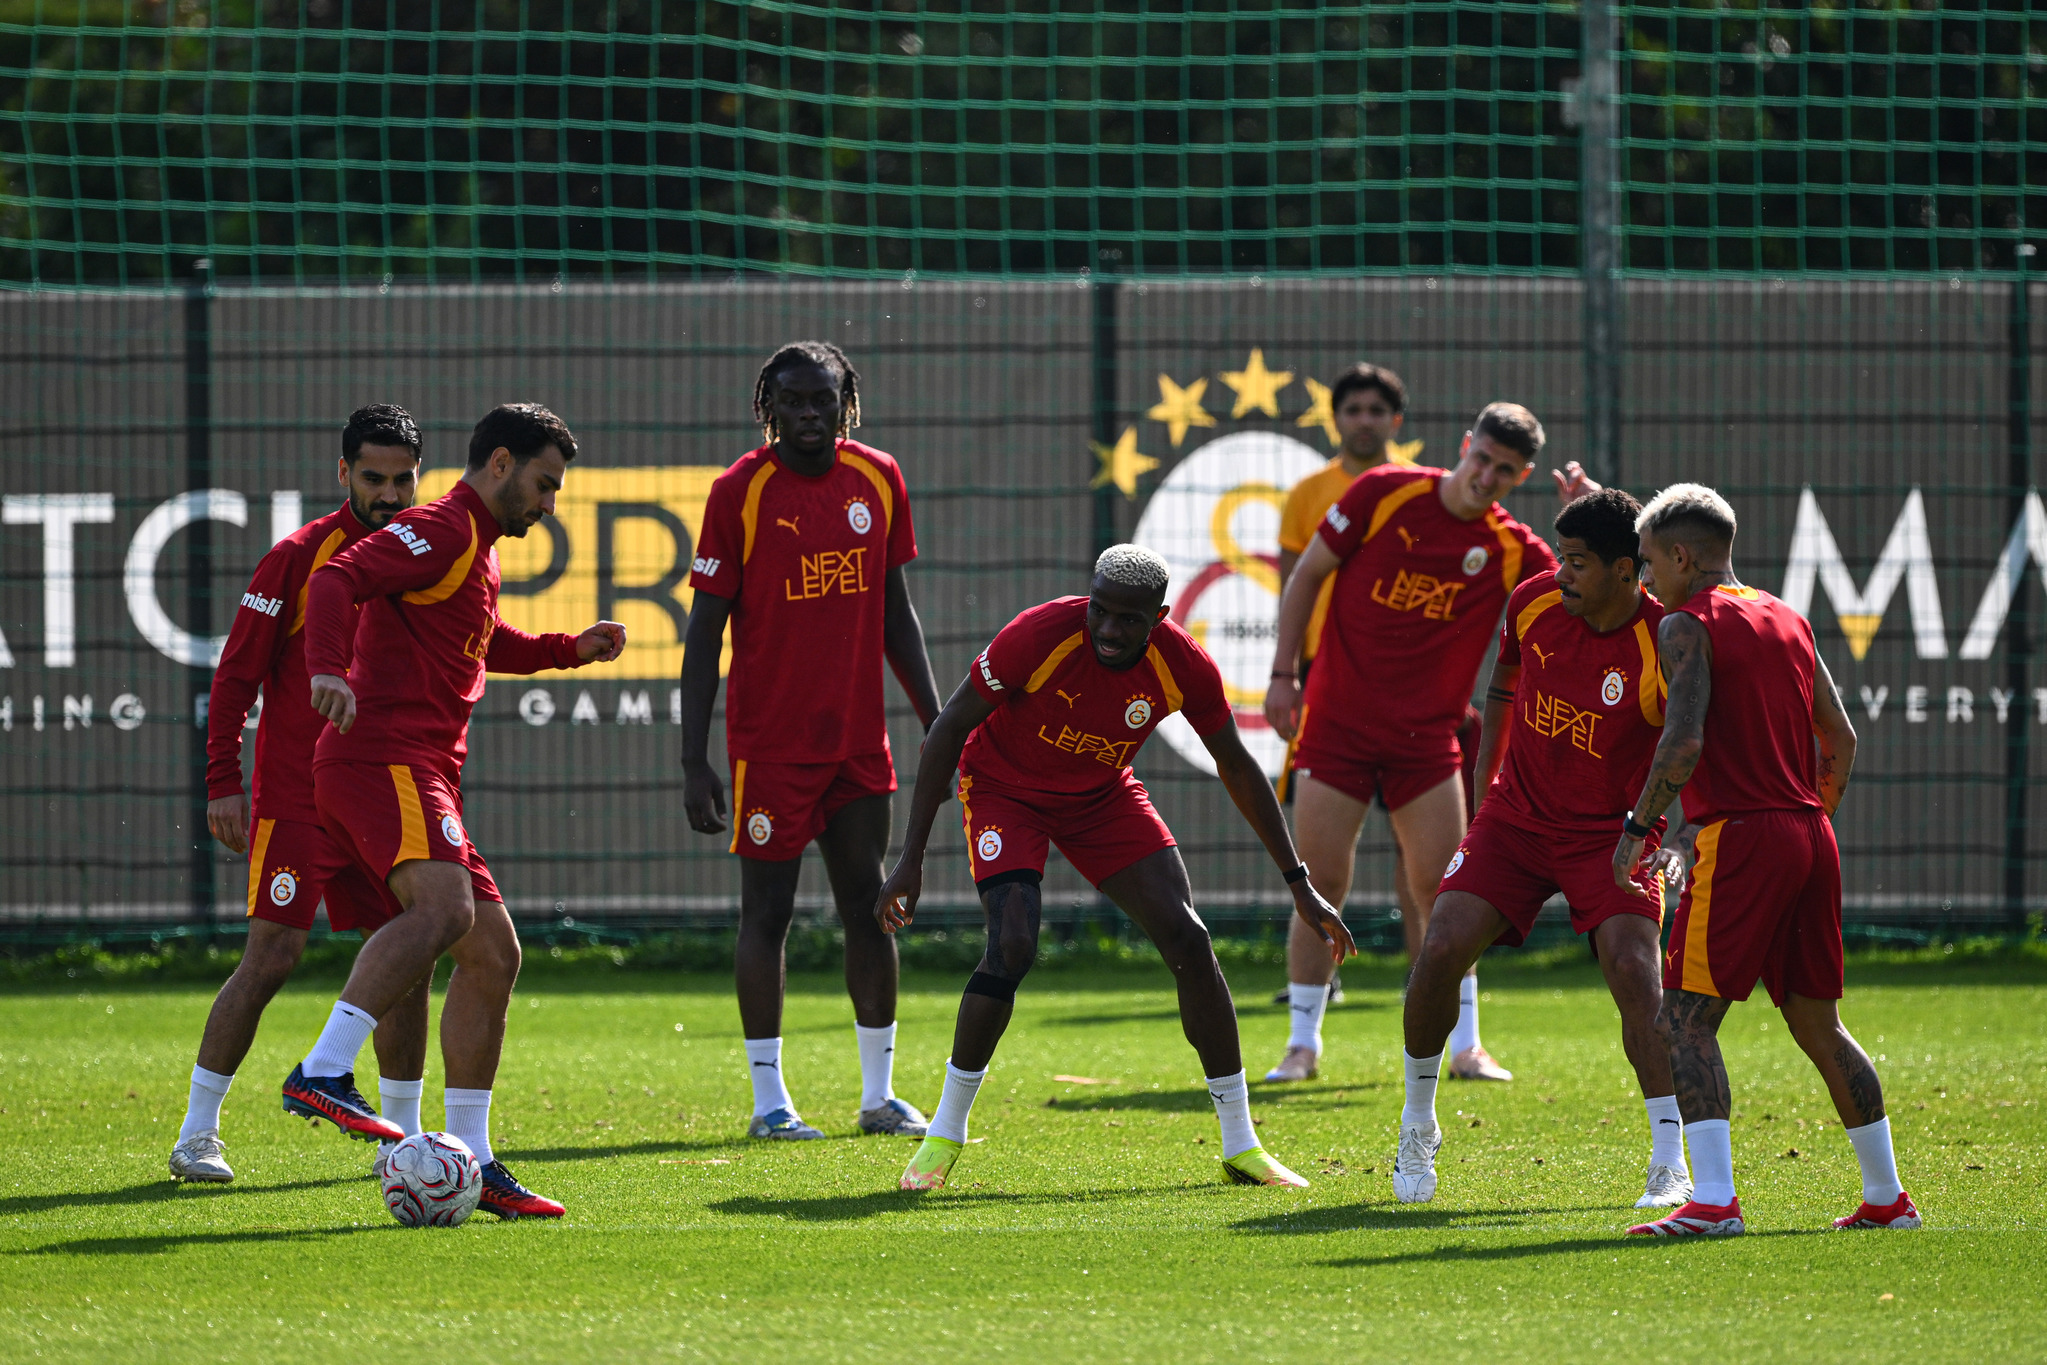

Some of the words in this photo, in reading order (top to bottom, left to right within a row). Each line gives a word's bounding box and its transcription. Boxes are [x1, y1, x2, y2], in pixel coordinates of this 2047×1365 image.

[0, 488, 302, 669] TC
[801, 547, 867, 577] NEXT
[1396, 567, 1466, 600] NEXT
[785, 569, 869, 601] LEVEL
[1370, 577, 1457, 621] LEVEL
[1524, 700, 1602, 759] LEVEL
[1536, 689, 1603, 733] NEXT
